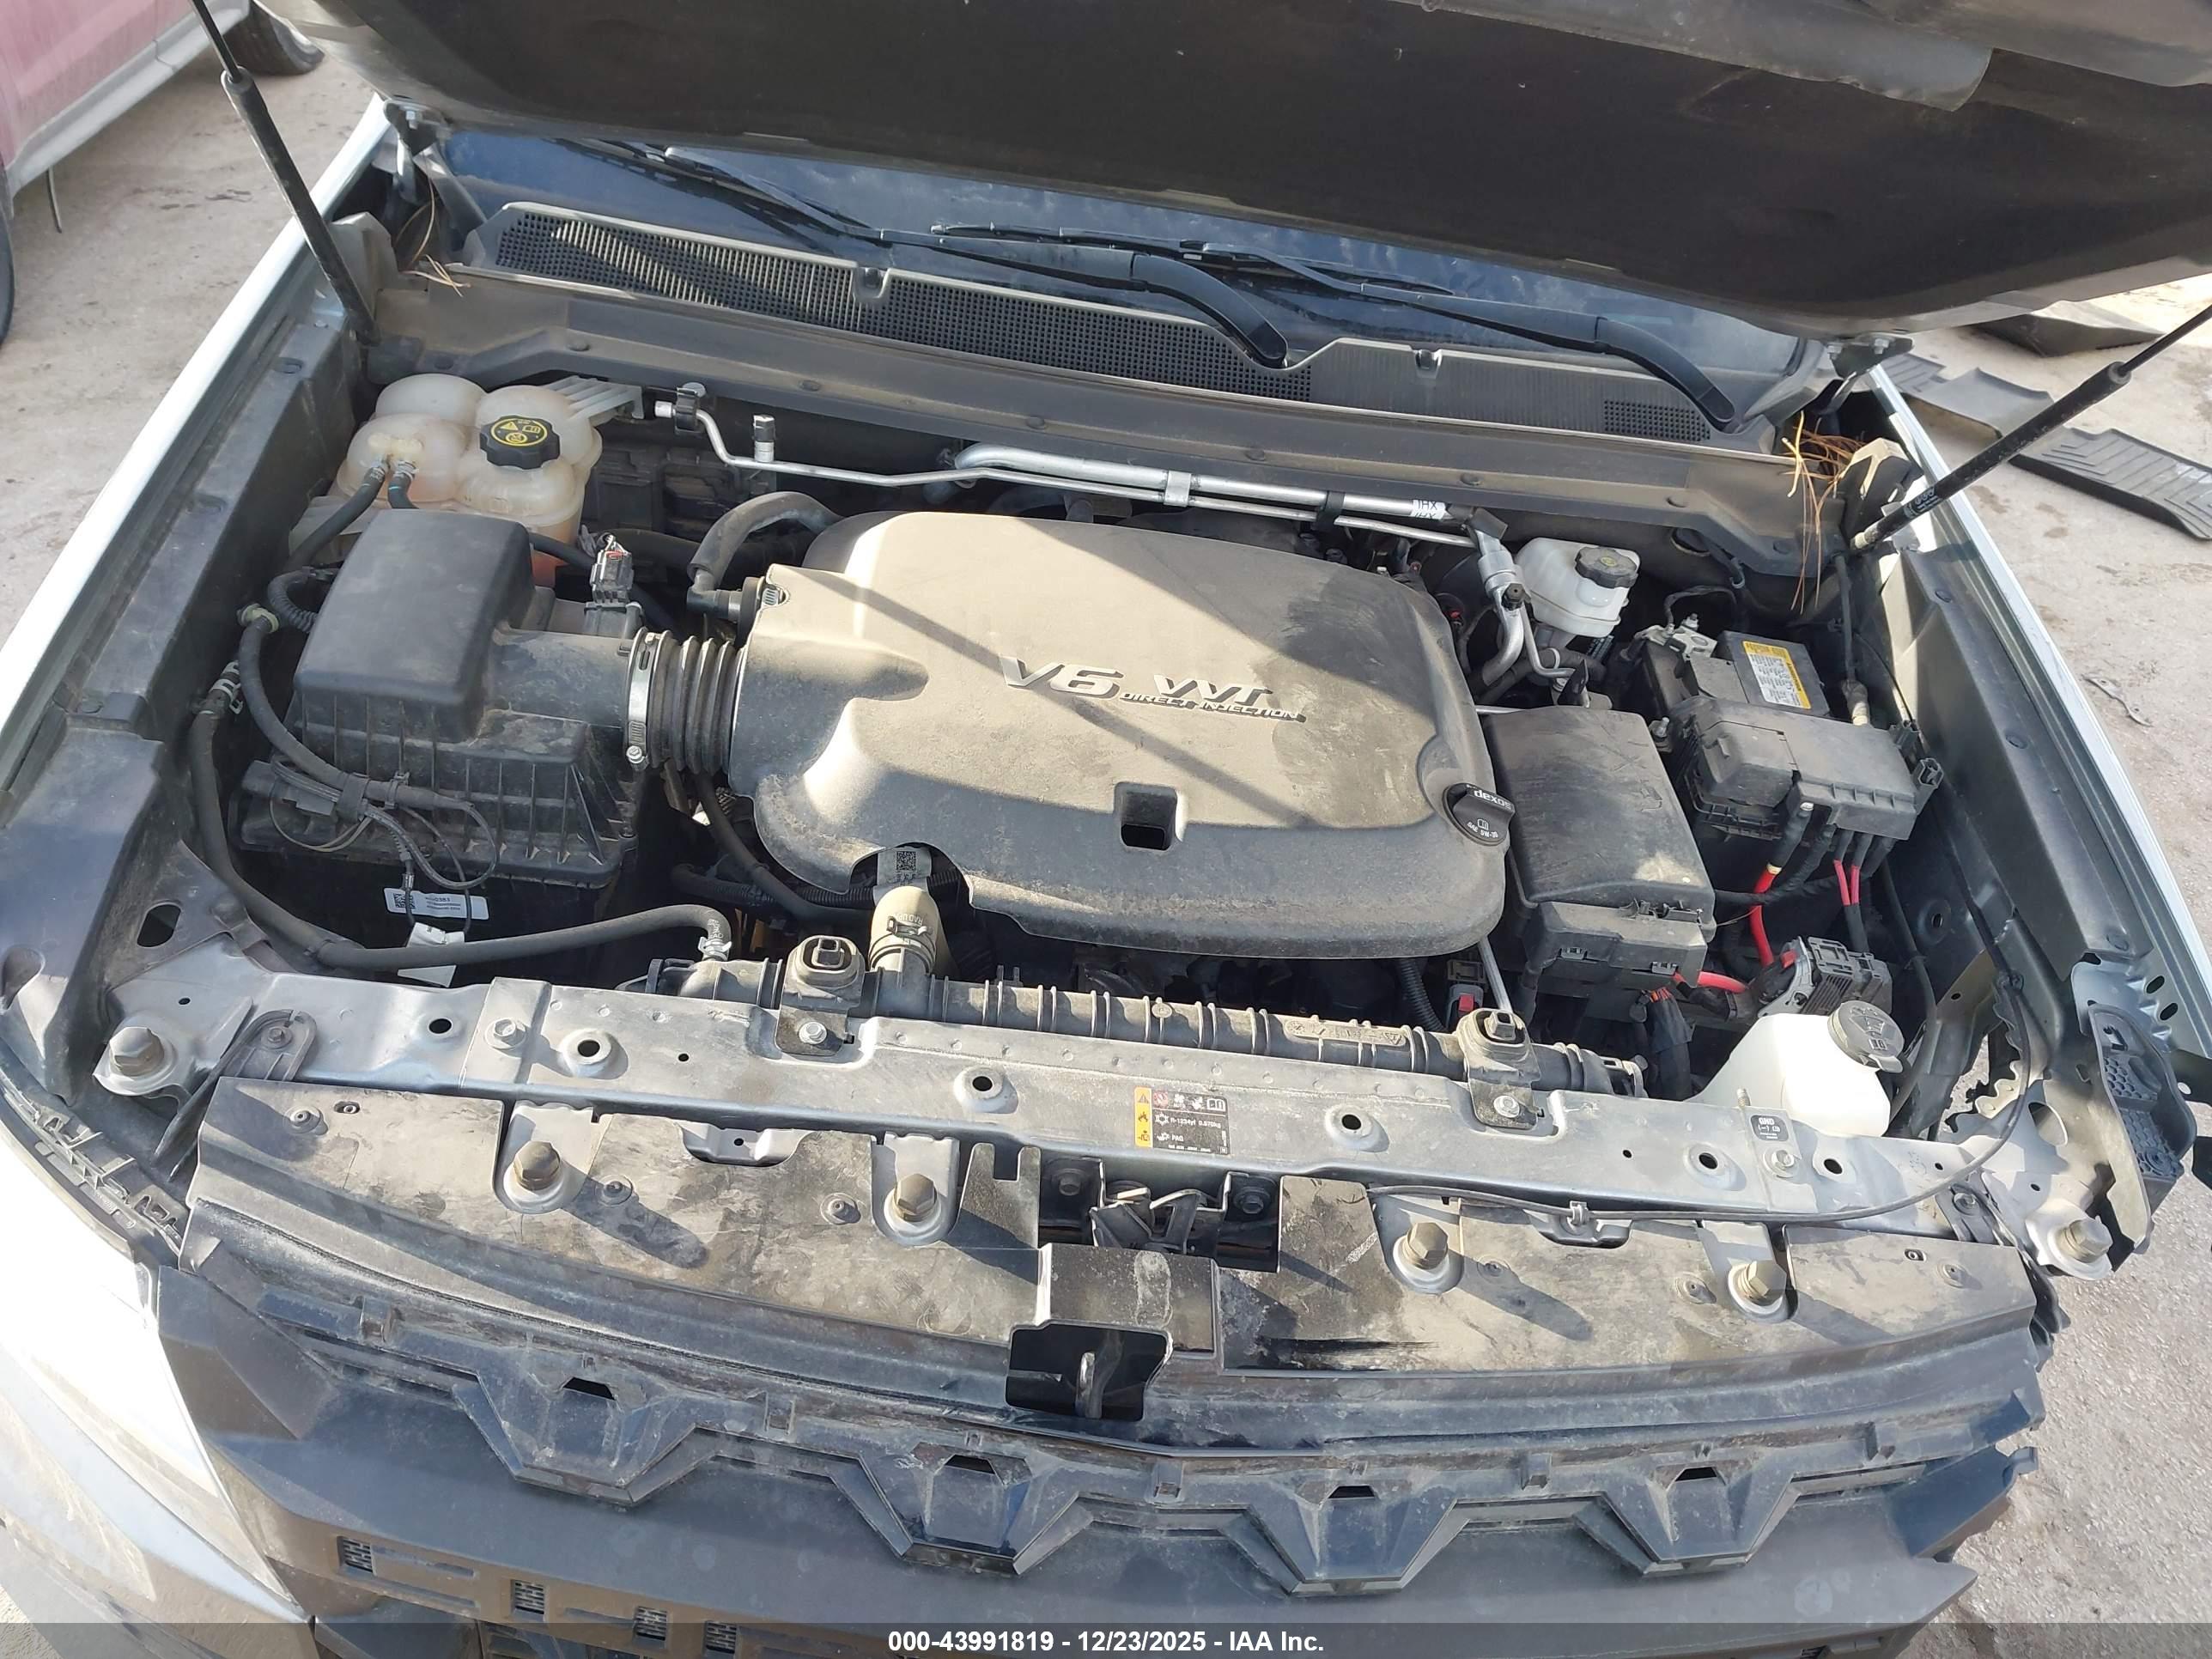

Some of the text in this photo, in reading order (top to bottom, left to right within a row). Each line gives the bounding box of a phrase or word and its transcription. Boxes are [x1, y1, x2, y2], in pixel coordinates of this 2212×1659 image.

[1000, 653, 1273, 706] V6 VVT
[1121, 692, 1306, 722] DIRECT INJECTION
